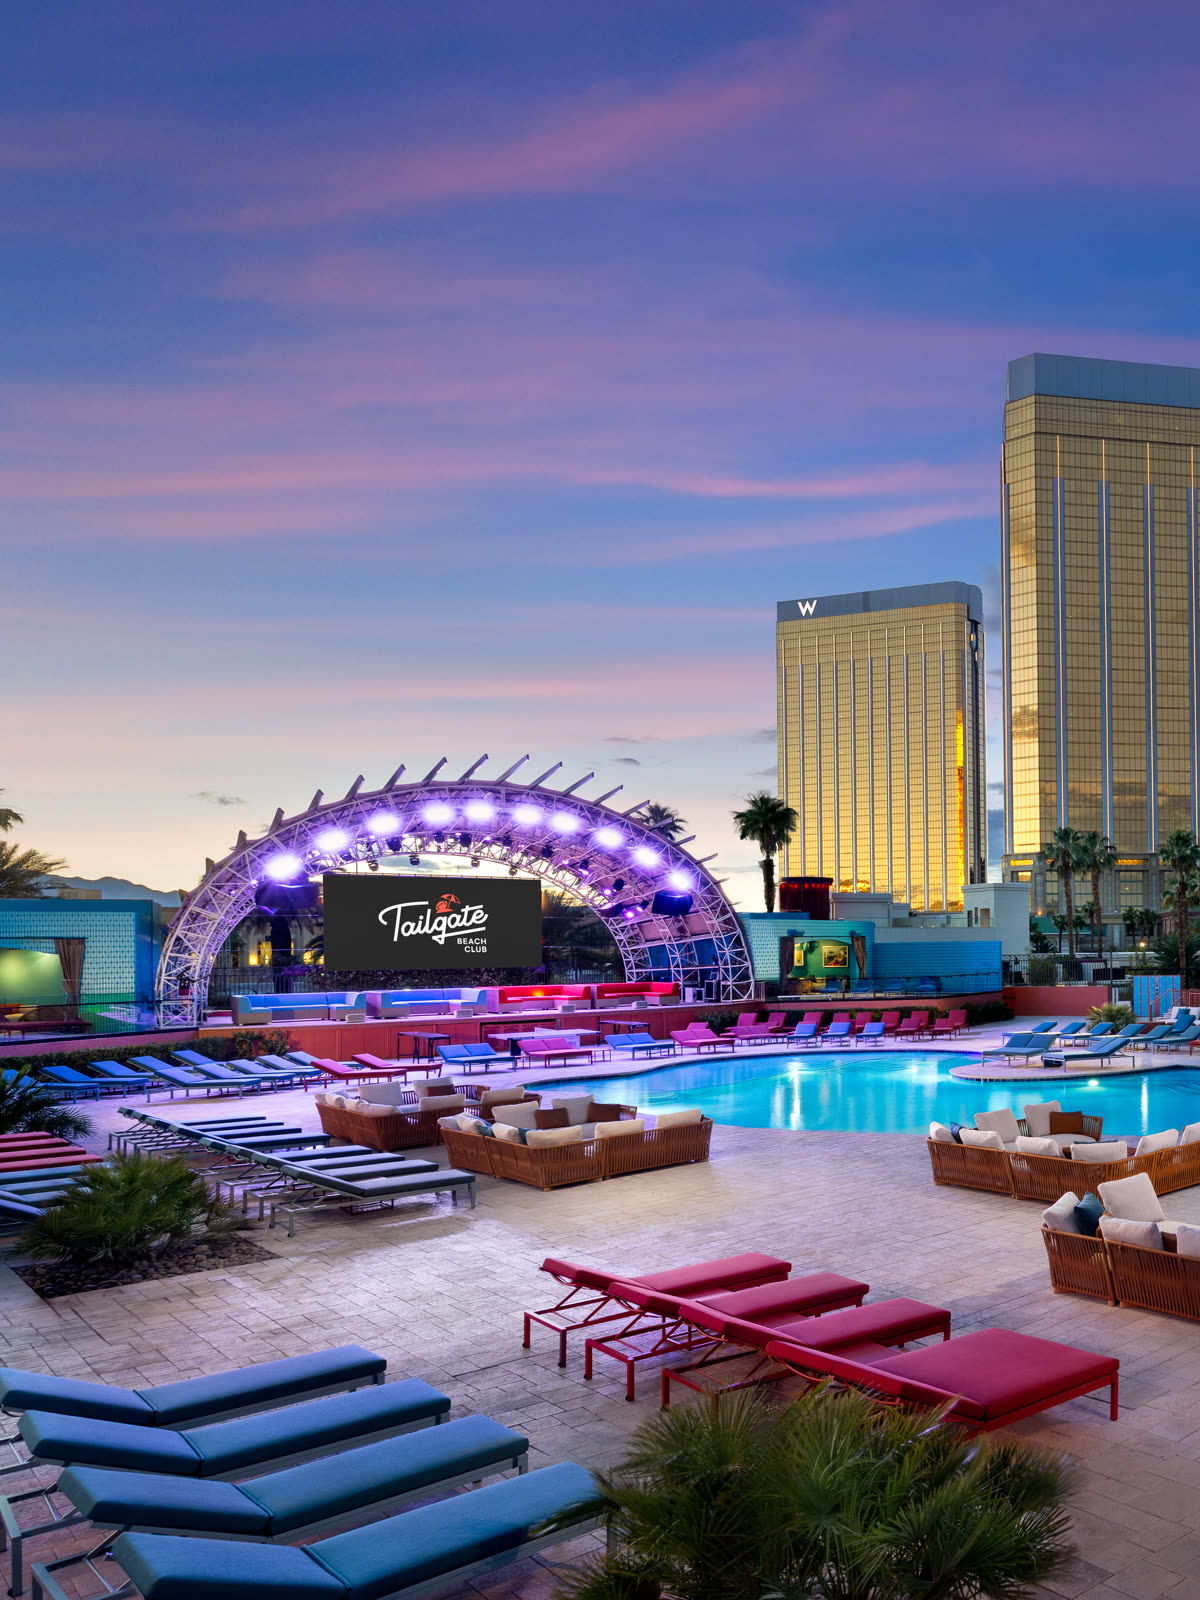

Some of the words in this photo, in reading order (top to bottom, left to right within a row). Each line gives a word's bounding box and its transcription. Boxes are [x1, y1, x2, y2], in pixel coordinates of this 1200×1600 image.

[797, 599, 818, 617] W
[377, 900, 489, 945] Tailgate
[456, 937, 487, 945] BEACH
[464, 945, 488, 953] CLUB
